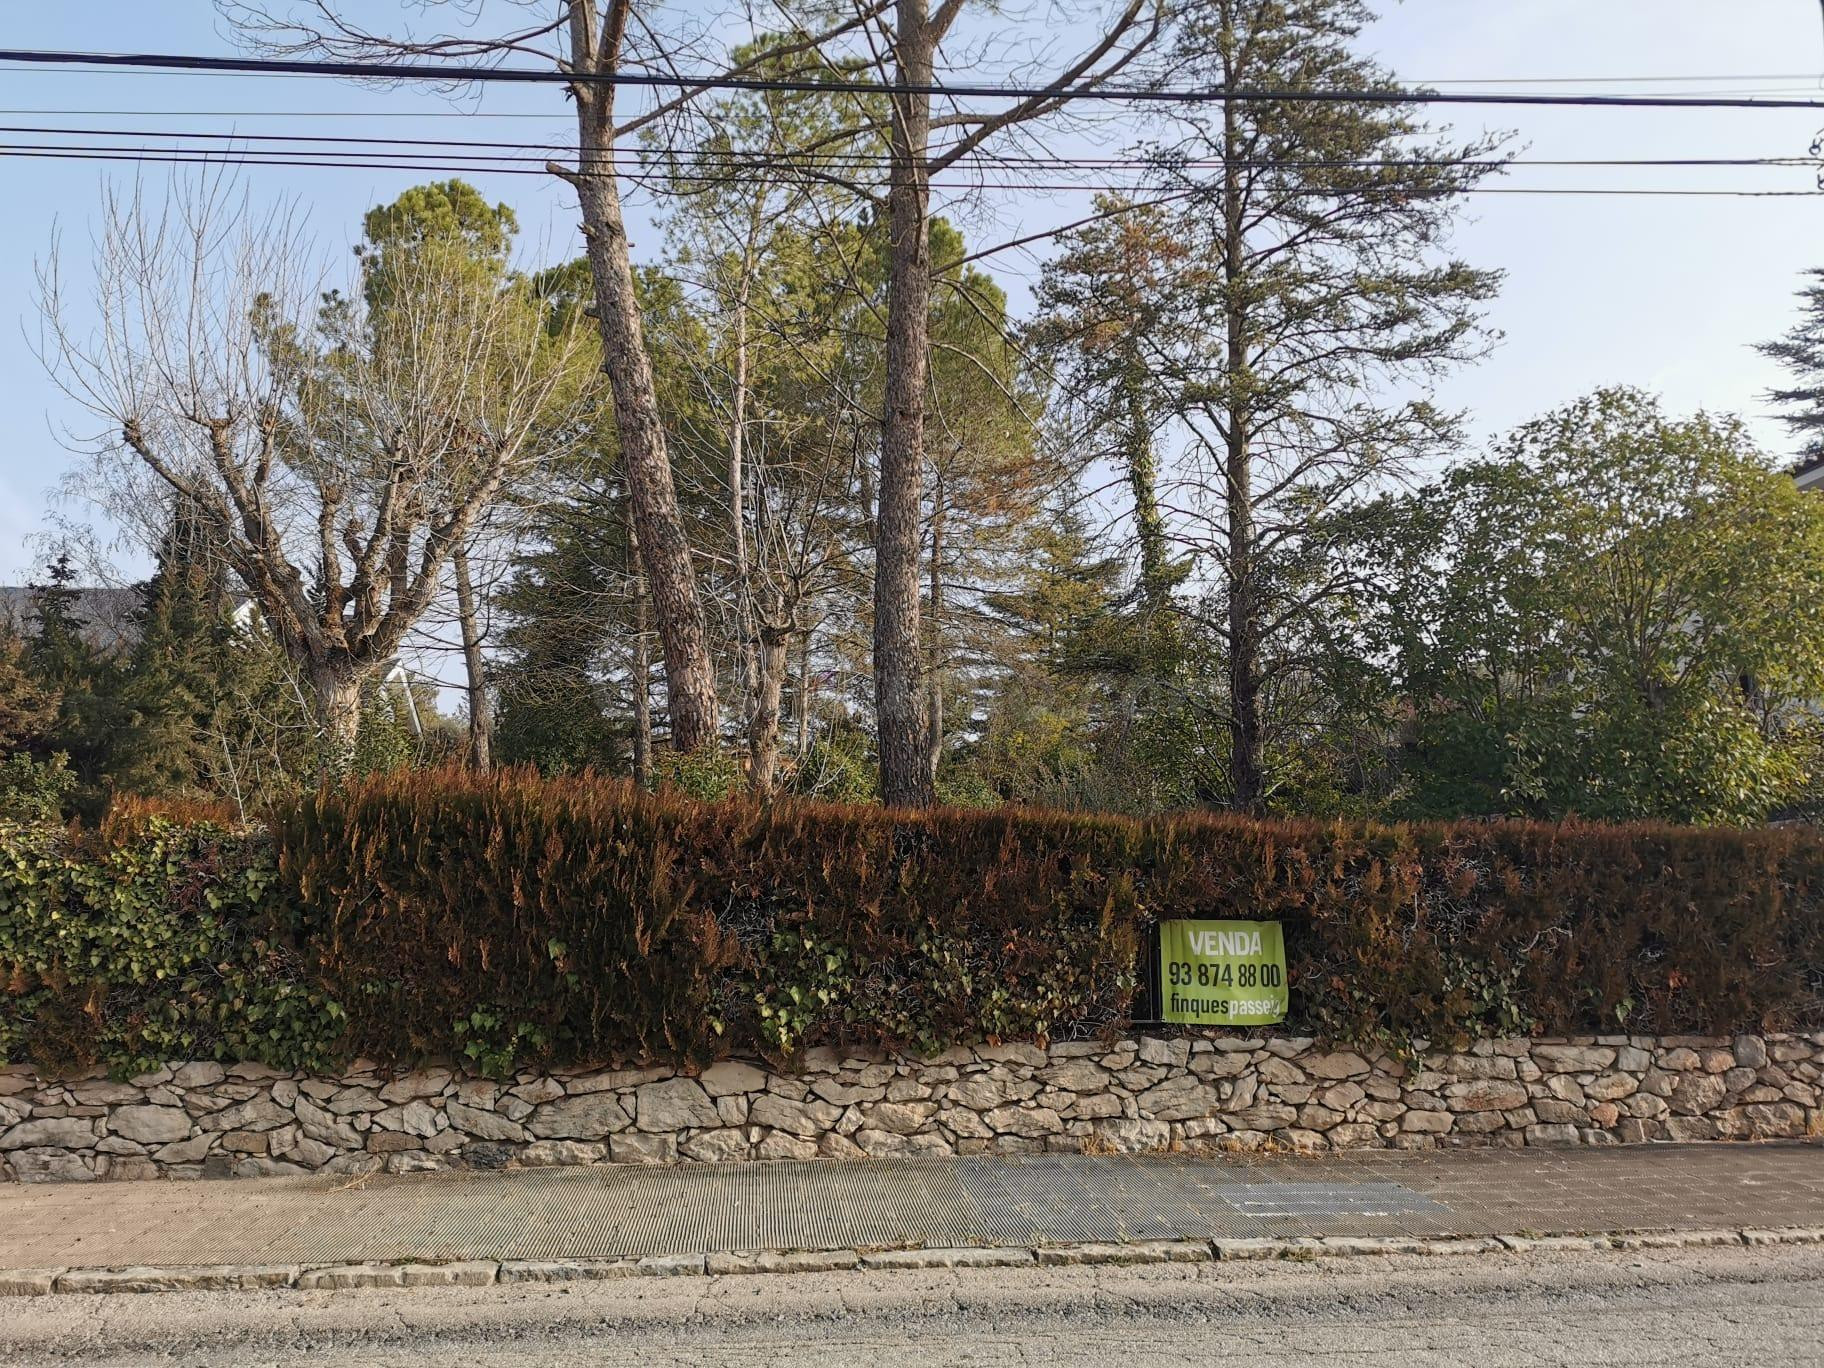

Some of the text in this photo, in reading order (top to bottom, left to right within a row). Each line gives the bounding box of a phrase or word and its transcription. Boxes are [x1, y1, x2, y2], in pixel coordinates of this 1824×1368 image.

[1188, 930, 1262, 956] VENDA
[1168, 961, 1192, 986] 93
[1197, 963, 1233, 987] 874
